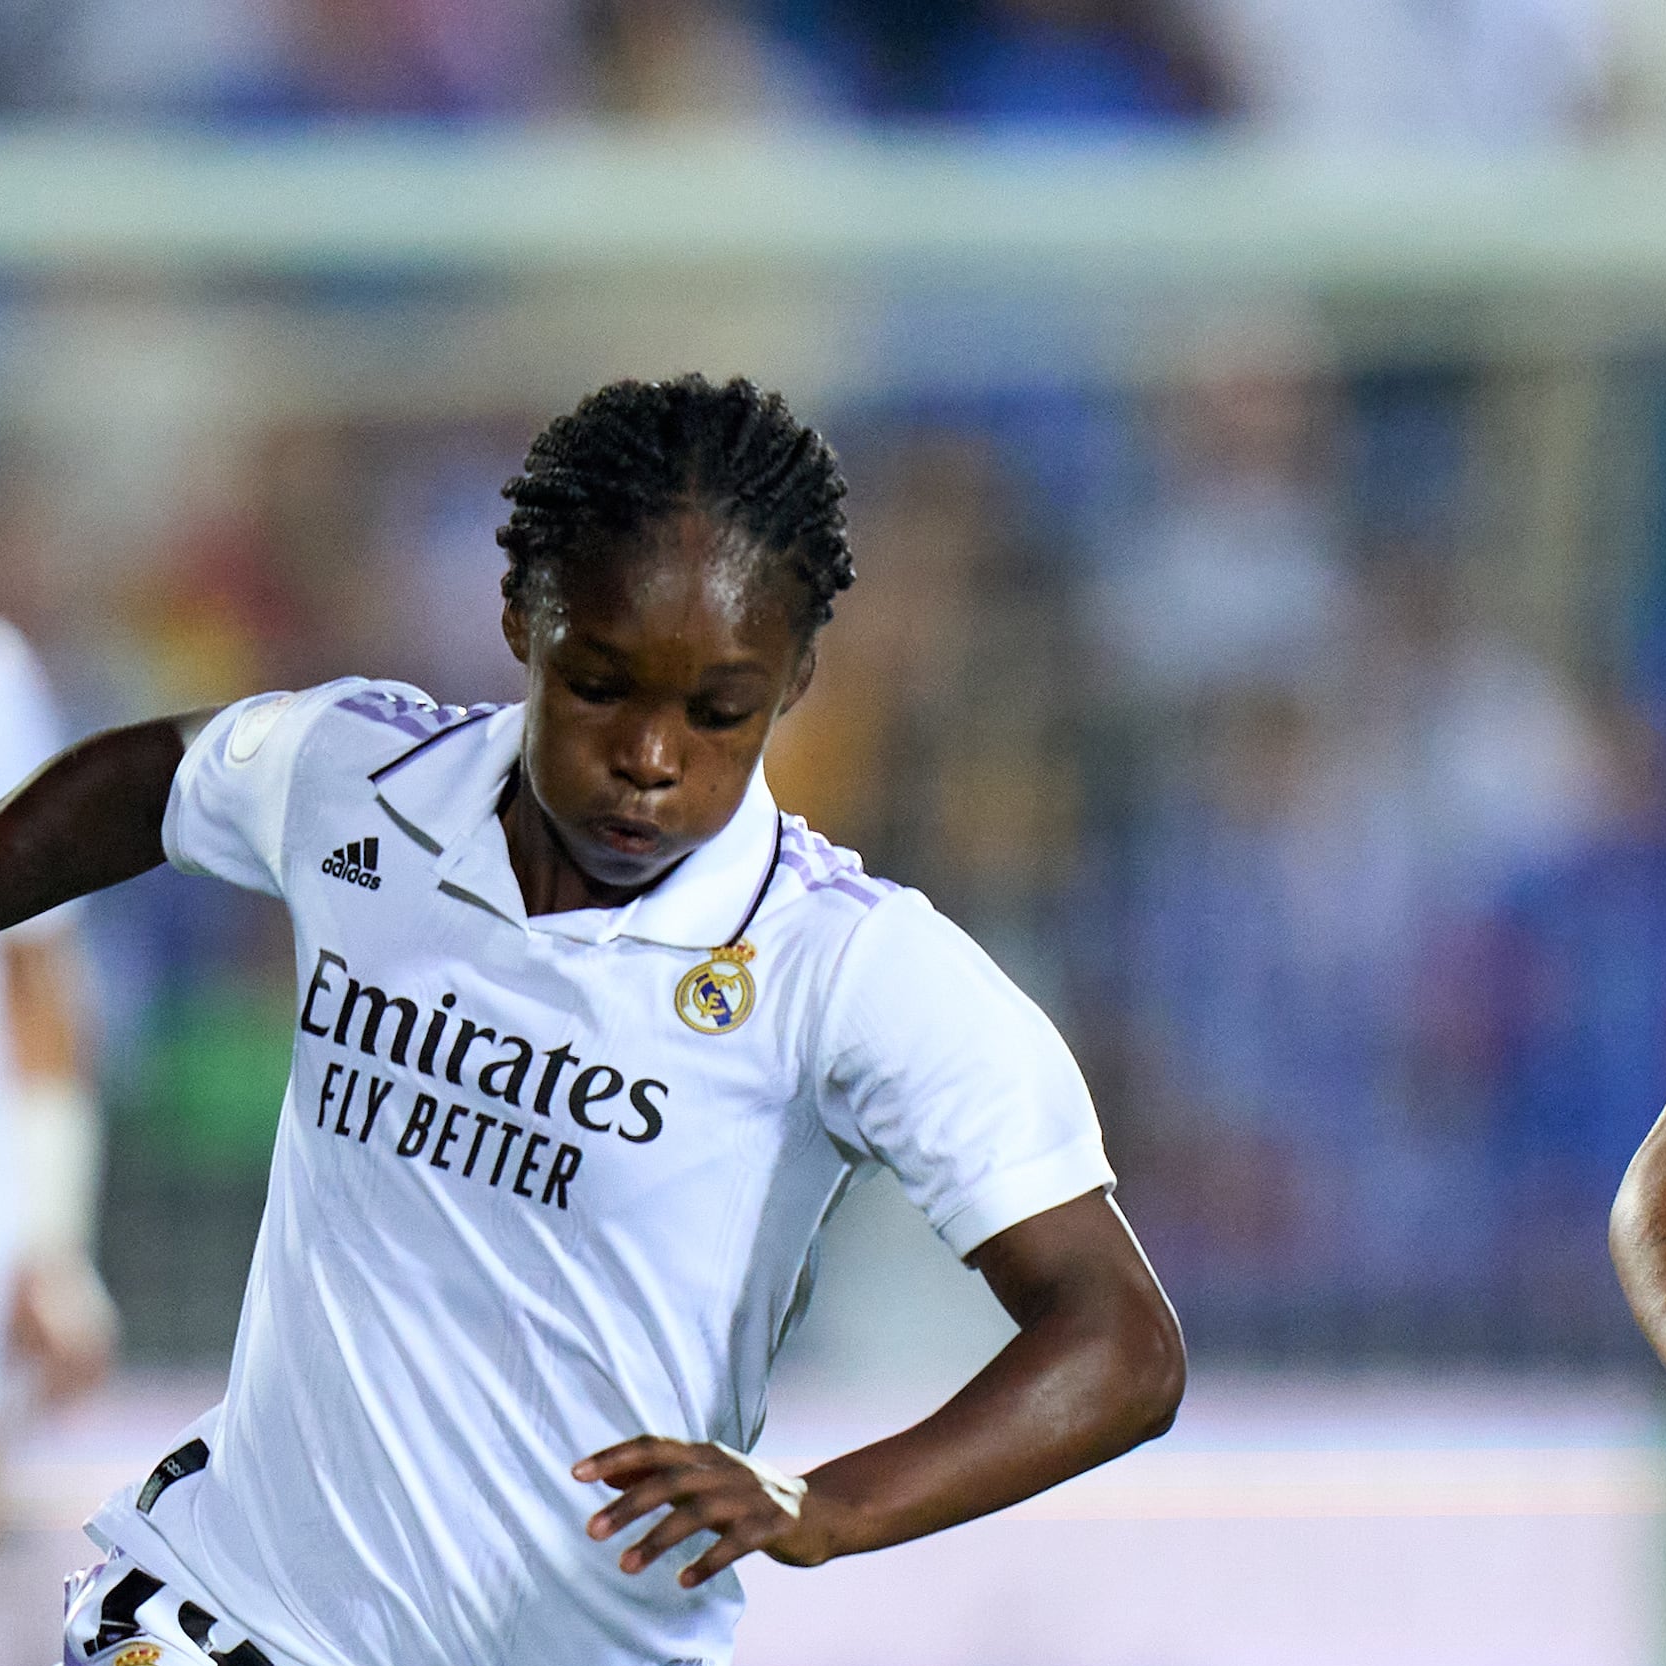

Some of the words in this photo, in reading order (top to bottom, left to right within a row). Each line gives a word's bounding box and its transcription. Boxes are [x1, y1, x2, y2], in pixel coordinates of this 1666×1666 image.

[321, 857, 382, 891] adidas
[300, 947, 670, 1145] Emirates
[317, 1061, 395, 1144] FLY
[396, 1093, 585, 1210] BETTER
